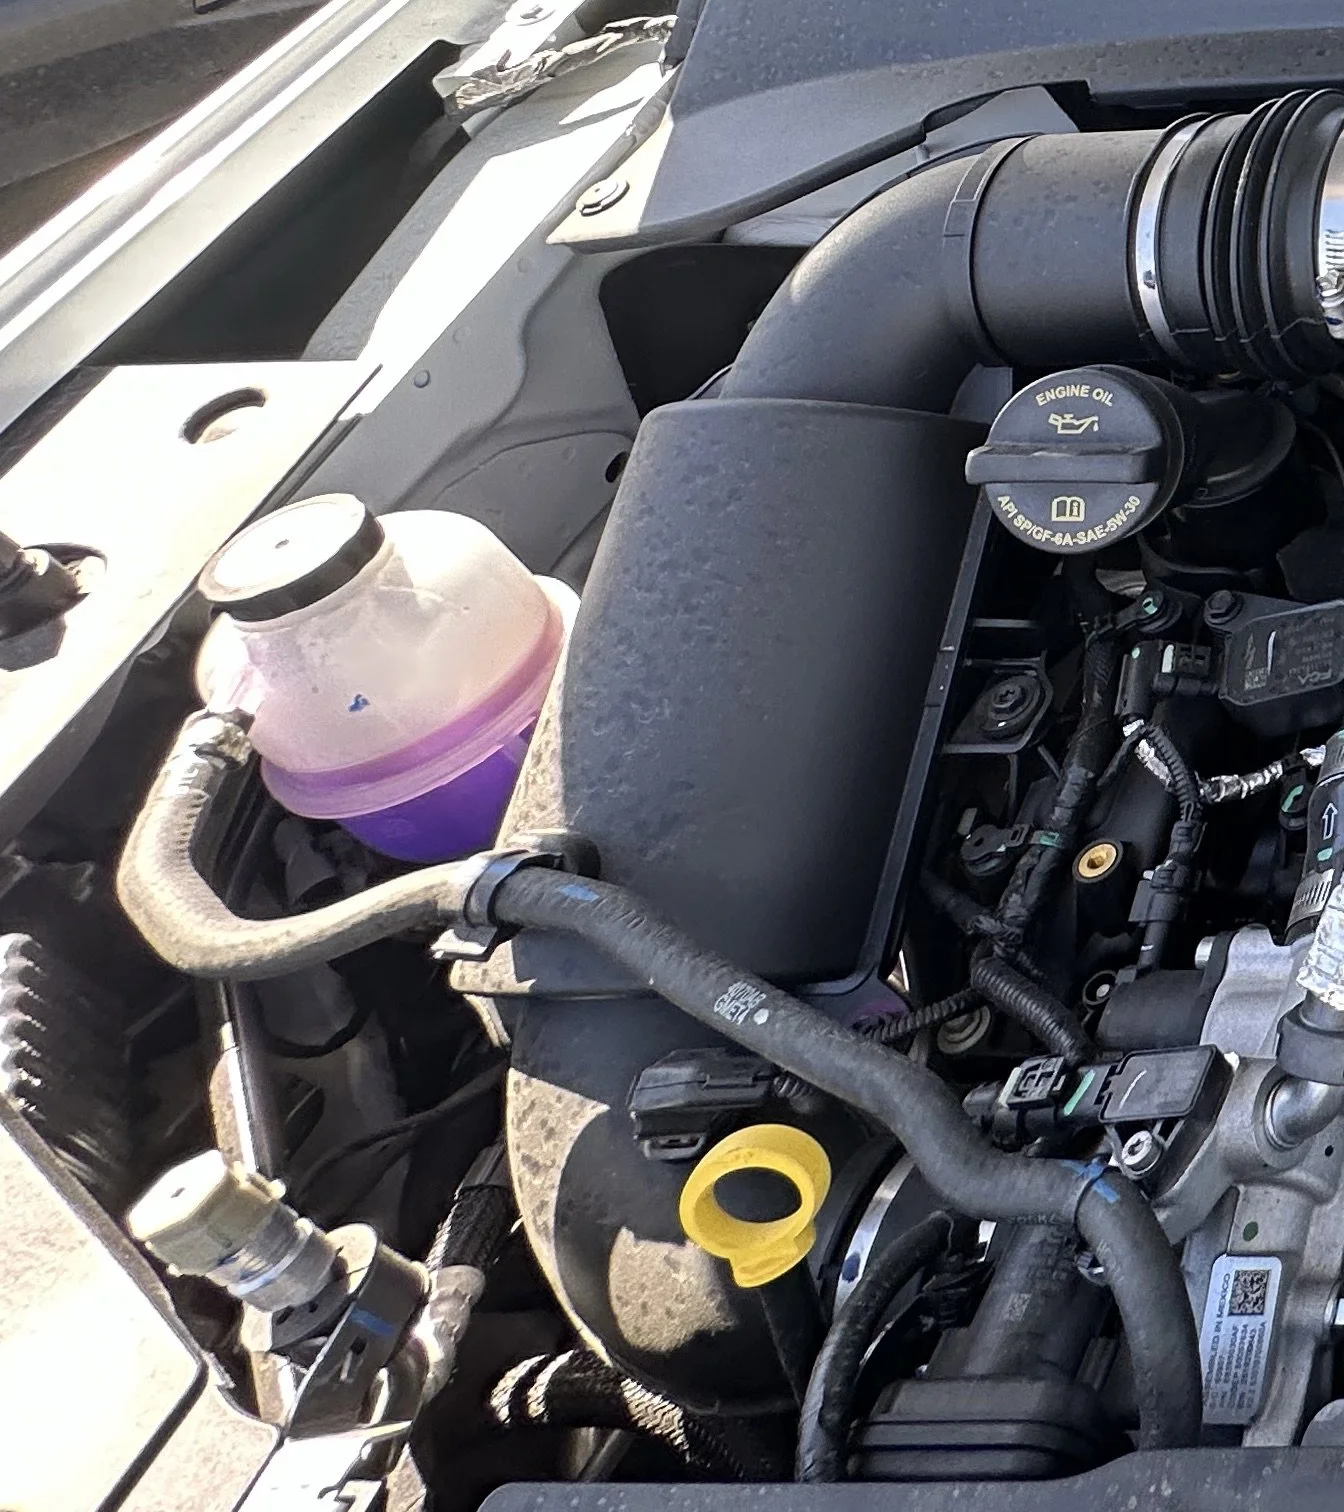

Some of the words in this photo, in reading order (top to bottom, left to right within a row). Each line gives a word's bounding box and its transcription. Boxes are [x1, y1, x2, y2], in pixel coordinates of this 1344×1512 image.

[1035, 384, 1090, 407] ENGINE
[1092, 387, 1114, 407] OIL
[997, 495, 1017, 518] API
[1216, 1273, 1230, 1318] MEXICO
